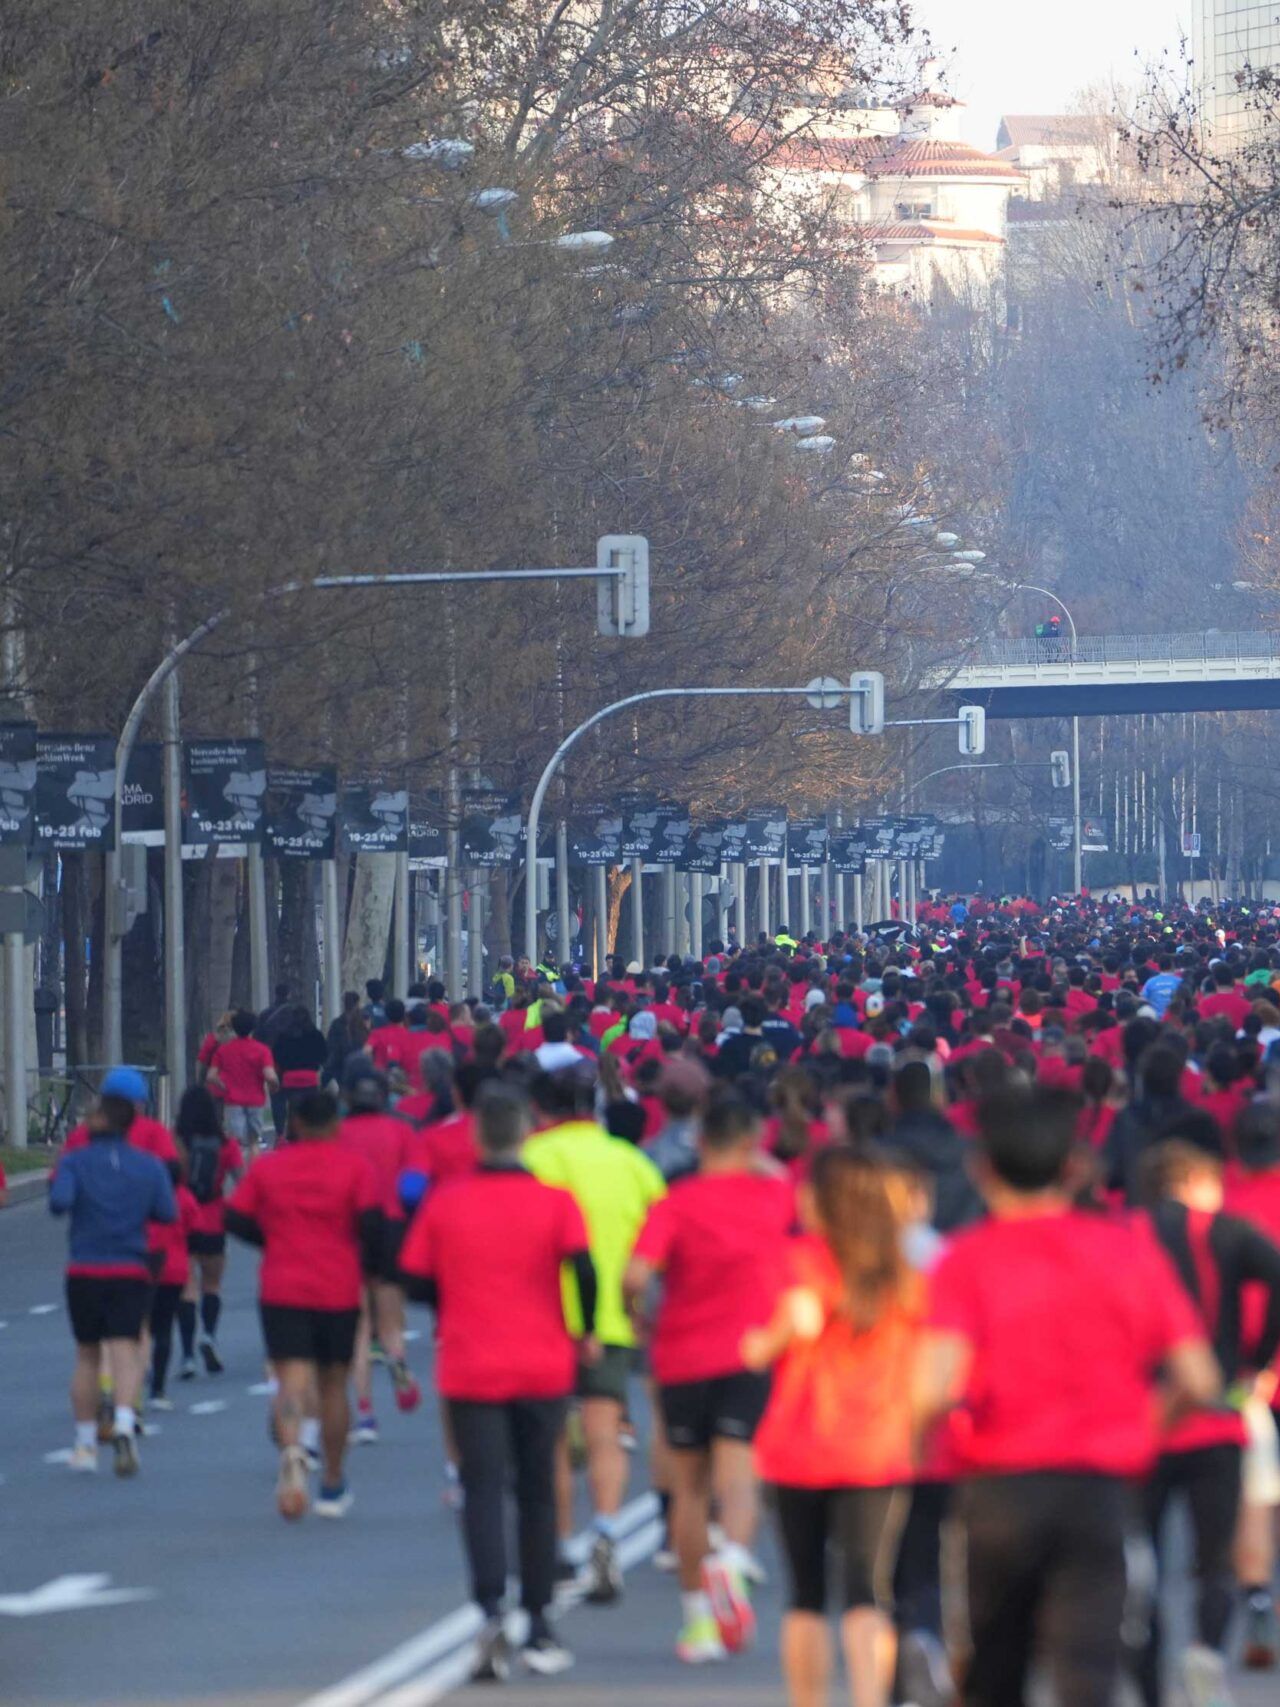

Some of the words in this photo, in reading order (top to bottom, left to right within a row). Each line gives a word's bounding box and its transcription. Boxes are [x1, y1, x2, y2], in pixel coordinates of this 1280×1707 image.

[38, 824, 77, 838] 19-23
[79, 824, 103, 838] feb
[199, 820, 233, 832] 19-23
[235, 820, 256, 831] feb
[273, 836, 304, 847] 19-23
[305, 837, 324, 848] feb
[349, 832, 379, 842] 19-23
[379, 831, 398, 842] feb
[578, 850, 602, 859] 19-23
[602, 849, 616, 858] feb
